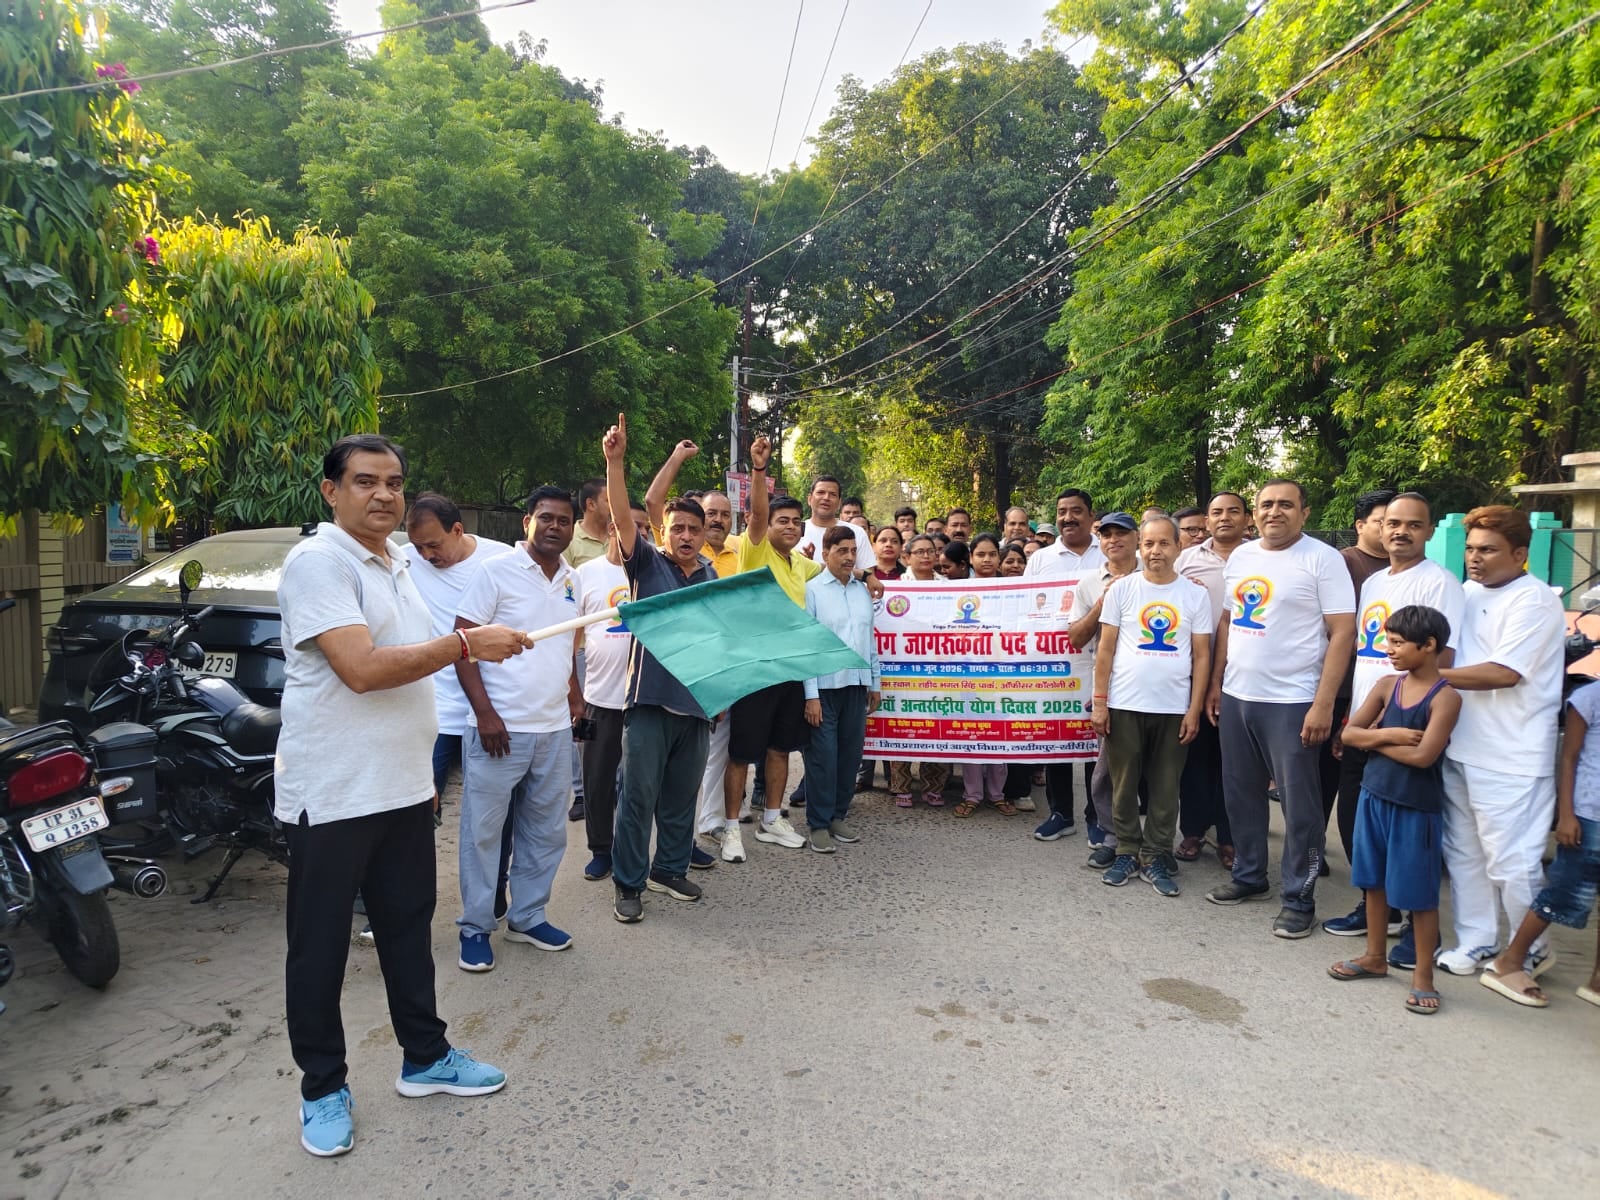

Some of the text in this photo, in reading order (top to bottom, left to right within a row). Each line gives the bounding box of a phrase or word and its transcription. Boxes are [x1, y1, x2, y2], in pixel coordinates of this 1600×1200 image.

[1000, 632, 1028, 655] पद
[923, 664, 938, 675] जून
[1020, 664, 1048, 672] 06:30
[1051, 662, 1066, 673] बजे
[901, 696, 965, 715] अन्तर्राष्ट्रीय
[970, 697, 995, 714] योग
[1000, 697, 1037, 714] दिवस
[1043, 700, 1082, 714] 2026
[43, 806, 84, 828] UP 31
[45, 816, 99, 843] Q 1258
